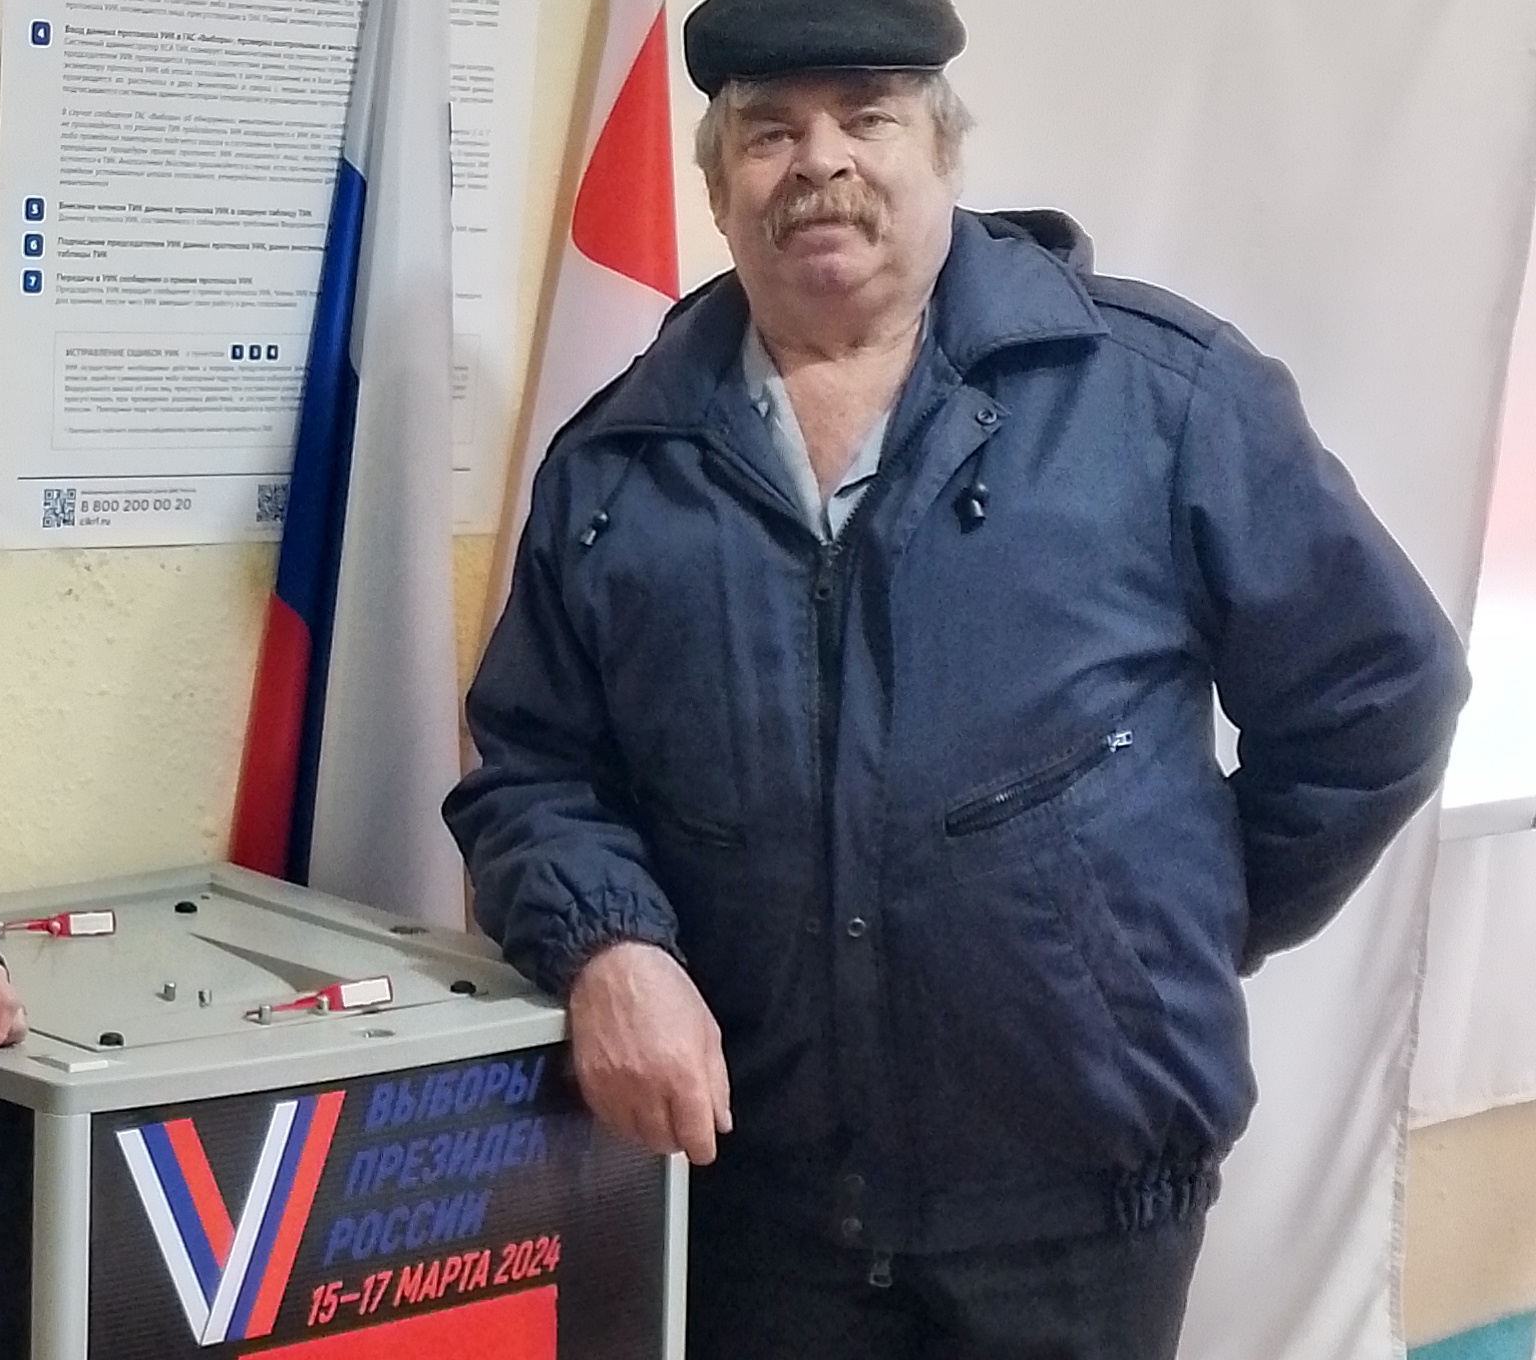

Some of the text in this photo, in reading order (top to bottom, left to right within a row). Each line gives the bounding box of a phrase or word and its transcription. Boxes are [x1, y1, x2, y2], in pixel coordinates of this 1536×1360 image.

[81, 496, 193, 513] 8 800 200 00 20
[365, 1054, 546, 1134] ВЫБОРЫ
[322, 1188, 494, 1267] РОССИИ
[395, 1252, 490, 1309] МАРТА
[494, 1234, 564, 1288] 2024
